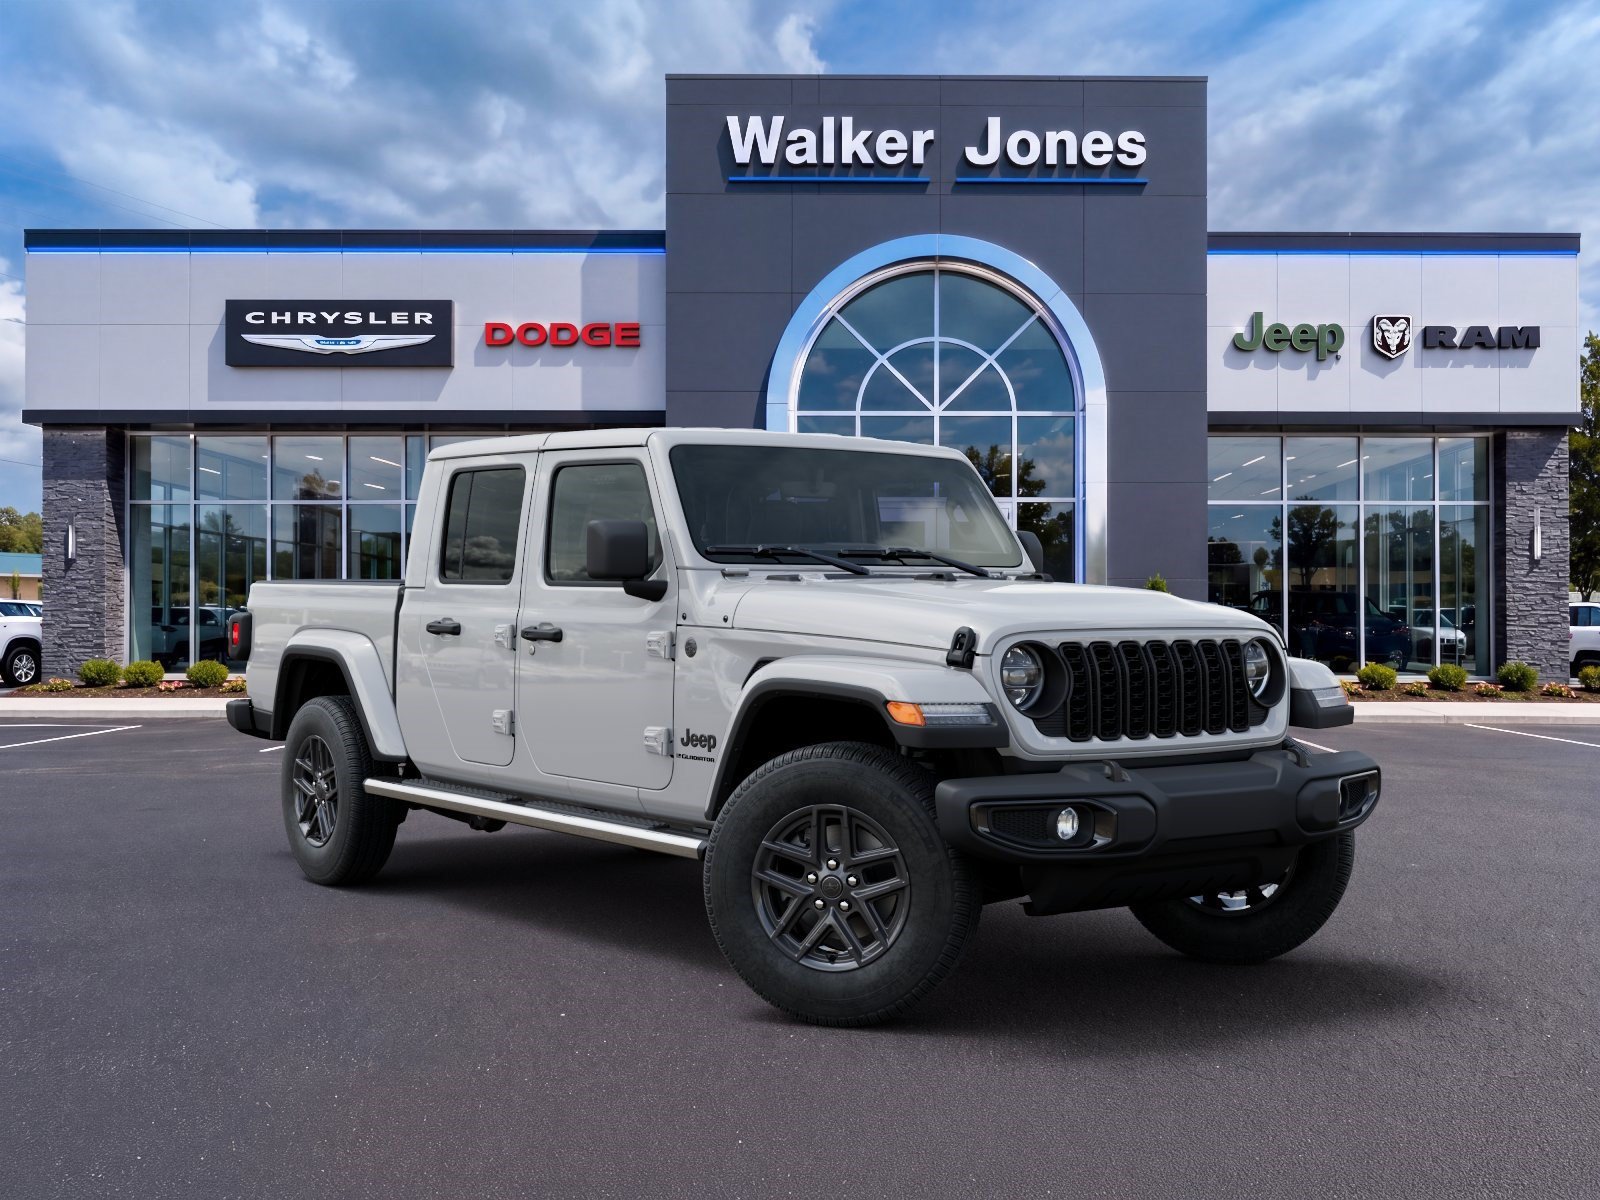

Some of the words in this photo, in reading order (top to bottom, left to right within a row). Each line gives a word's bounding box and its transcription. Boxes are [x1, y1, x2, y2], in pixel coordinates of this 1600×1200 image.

[726, 115, 935, 166] Walker
[964, 116, 1148, 167] Jones
[245, 311, 434, 325] CHRYSLER
[485, 322, 641, 347] DODGE
[1233, 311, 1345, 361] Jeep
[1424, 325, 1541, 348] RAM
[680, 728, 717, 752] Jeep
